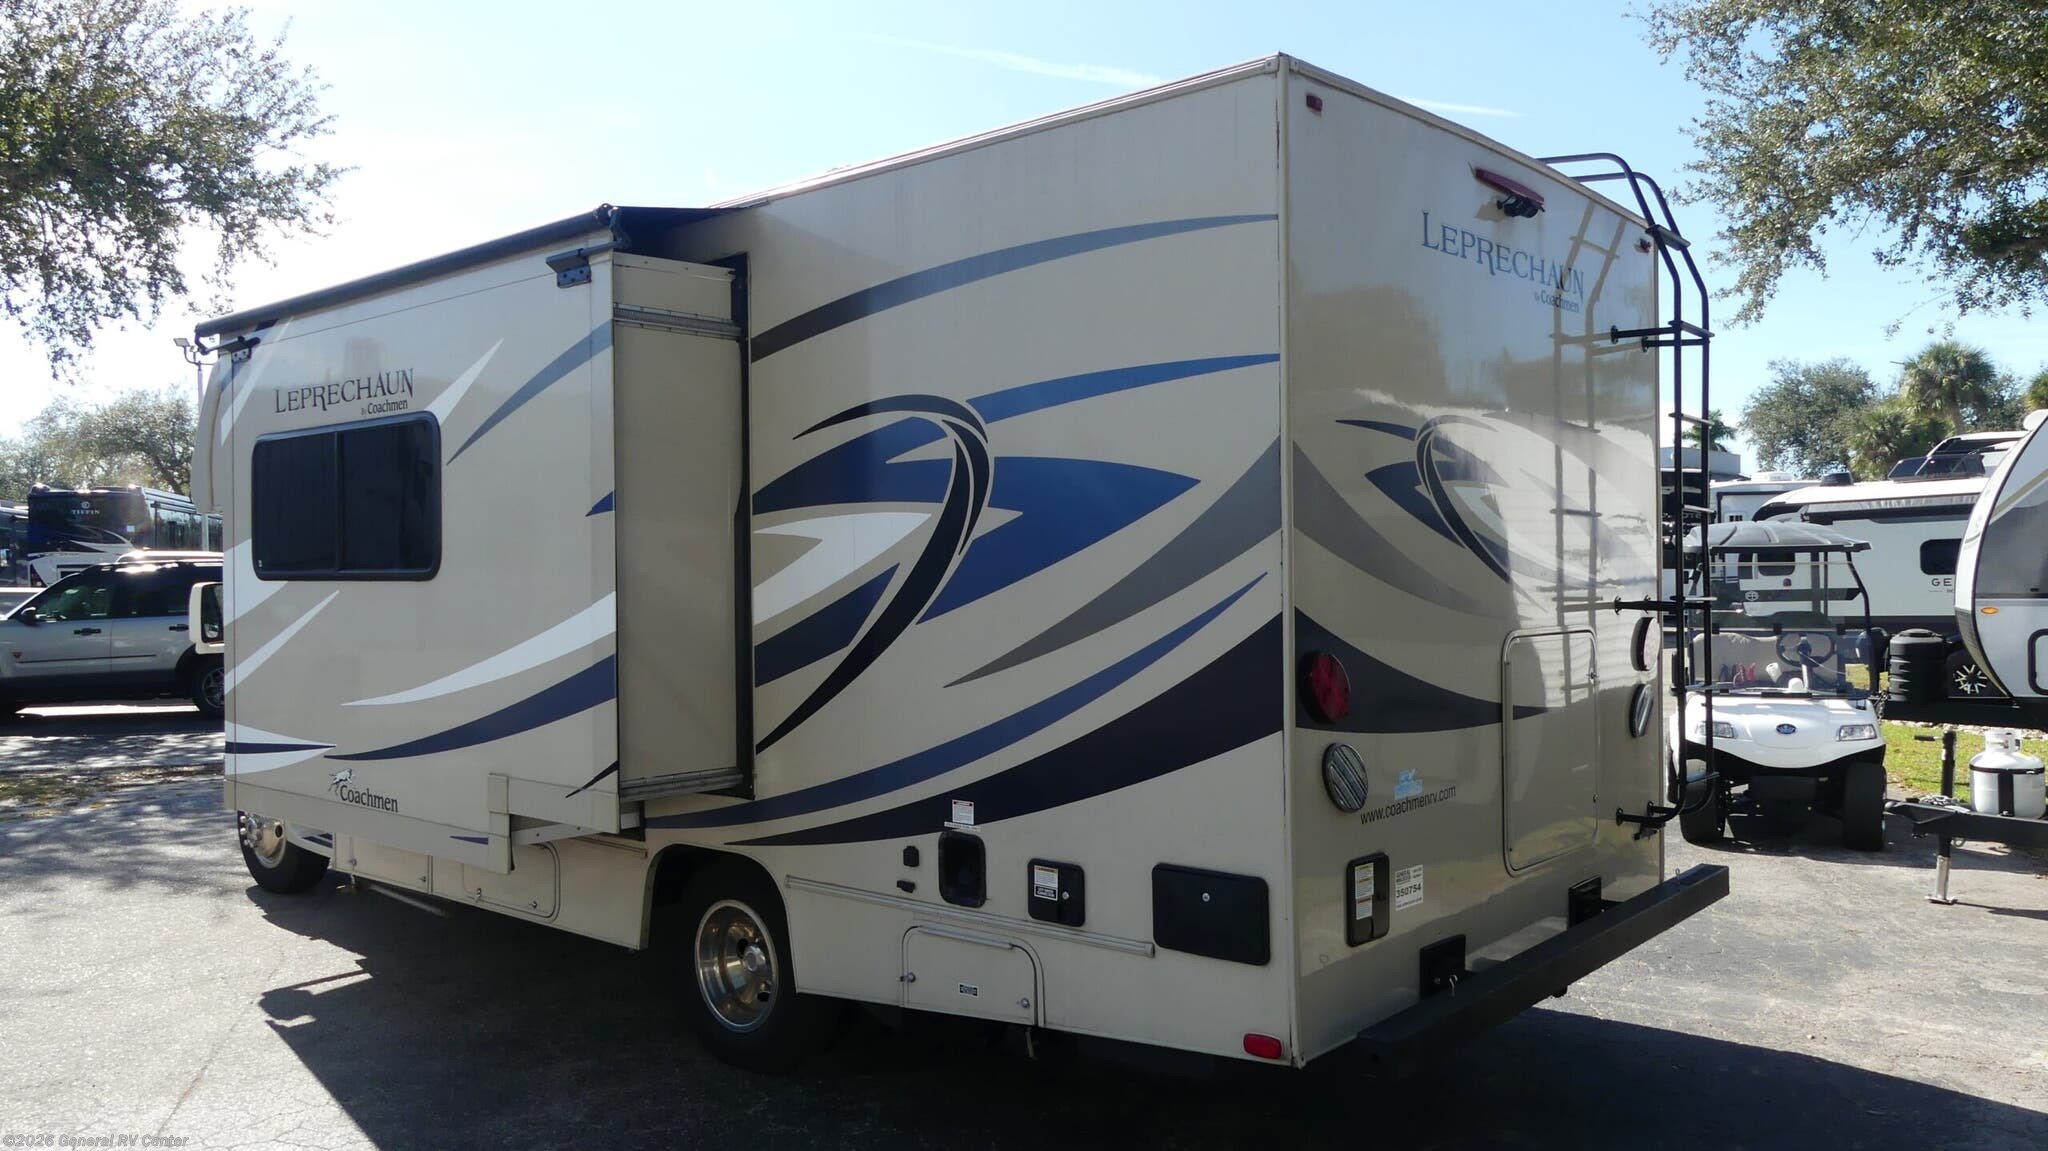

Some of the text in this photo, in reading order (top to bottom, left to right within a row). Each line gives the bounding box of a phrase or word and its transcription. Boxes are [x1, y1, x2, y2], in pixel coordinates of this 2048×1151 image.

[1421, 210, 1584, 303] LEPRECHAUN
[1540, 290, 1580, 313] Coachmen
[274, 367, 414, 414] LEPRECHAUN
[367, 400, 408, 414] Coachmen
[1931, 577, 1953, 587] GE
[340, 785, 398, 812] Coachmen
[1360, 785, 1457, 825] www.coachmenrv.com
[1396, 883, 1421, 898] 350754
